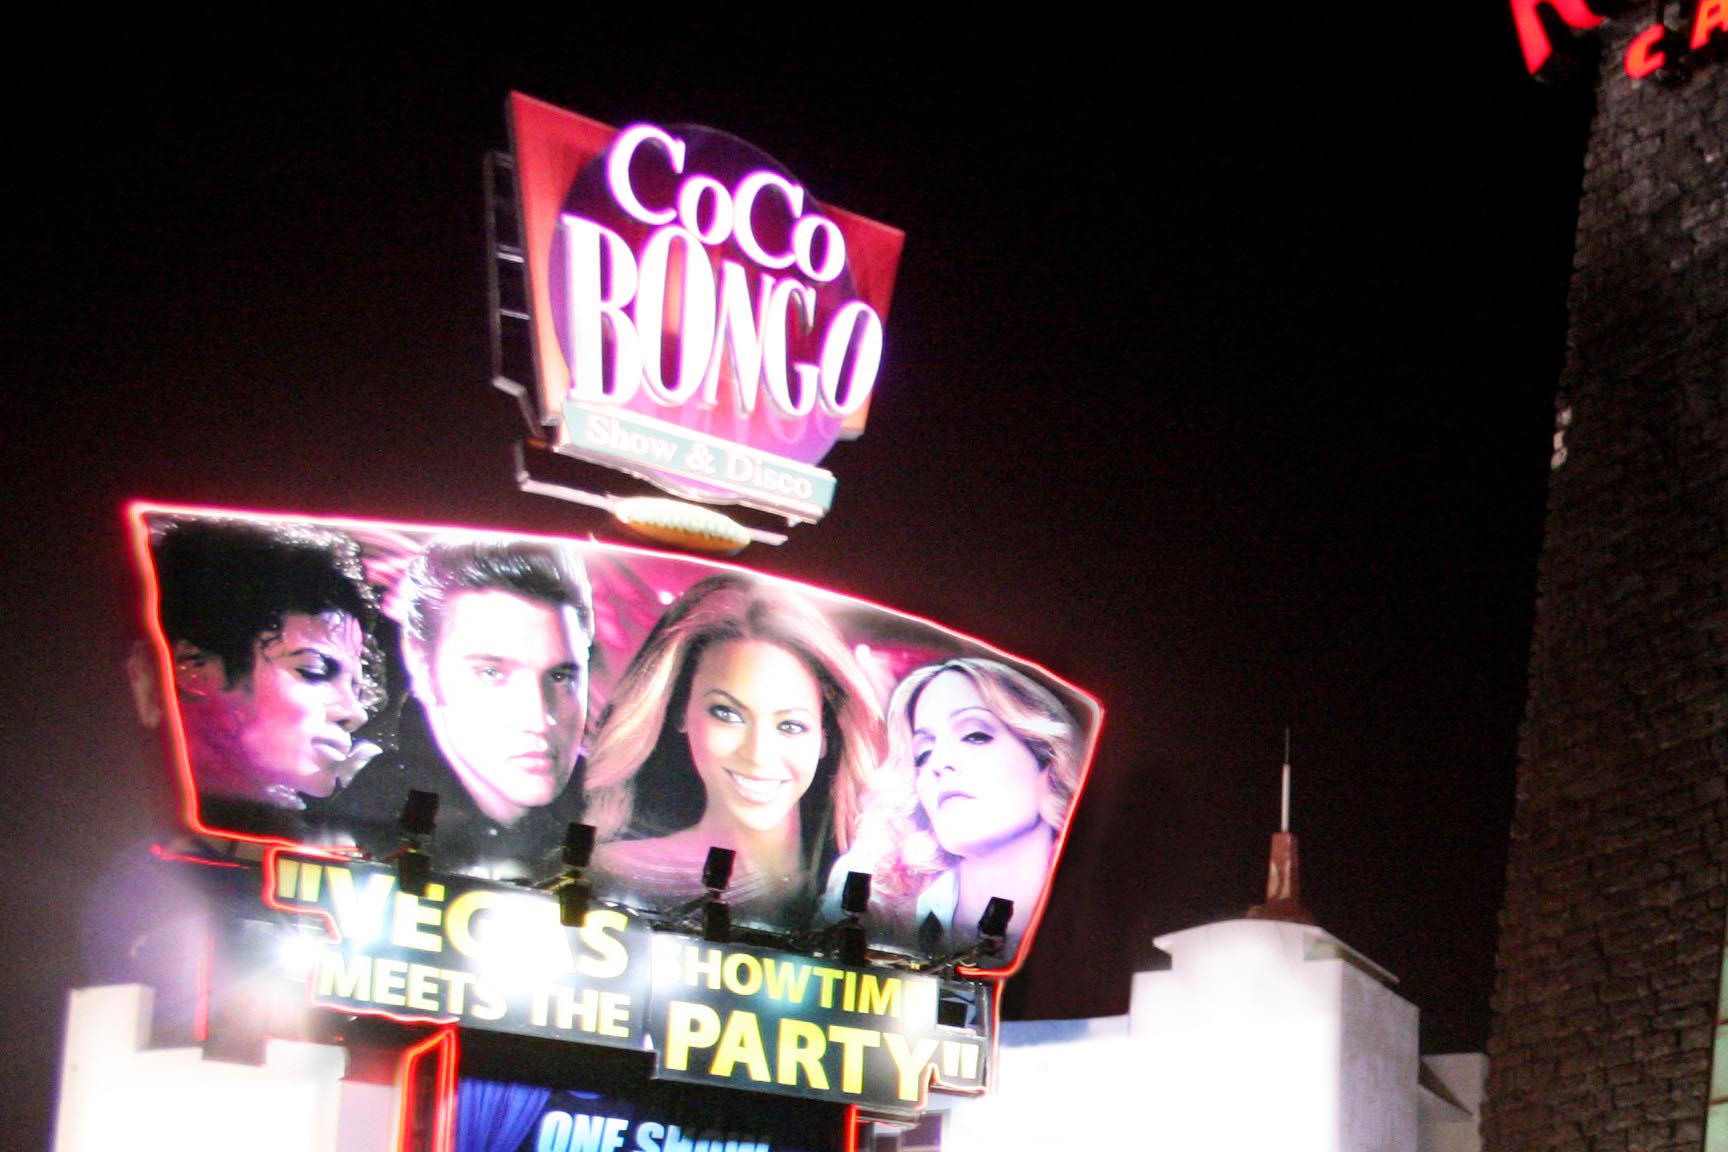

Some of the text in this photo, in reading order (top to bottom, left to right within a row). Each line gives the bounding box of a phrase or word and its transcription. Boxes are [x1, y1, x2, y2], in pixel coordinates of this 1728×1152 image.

[560, 212, 884, 419] BONGO
[586, 414, 814, 499] Show & Disco
[279, 859, 629, 979] "VEGS
[317, 952, 631, 1038] MEETS THE
[650, 933, 938, 1028] HOWTIM
